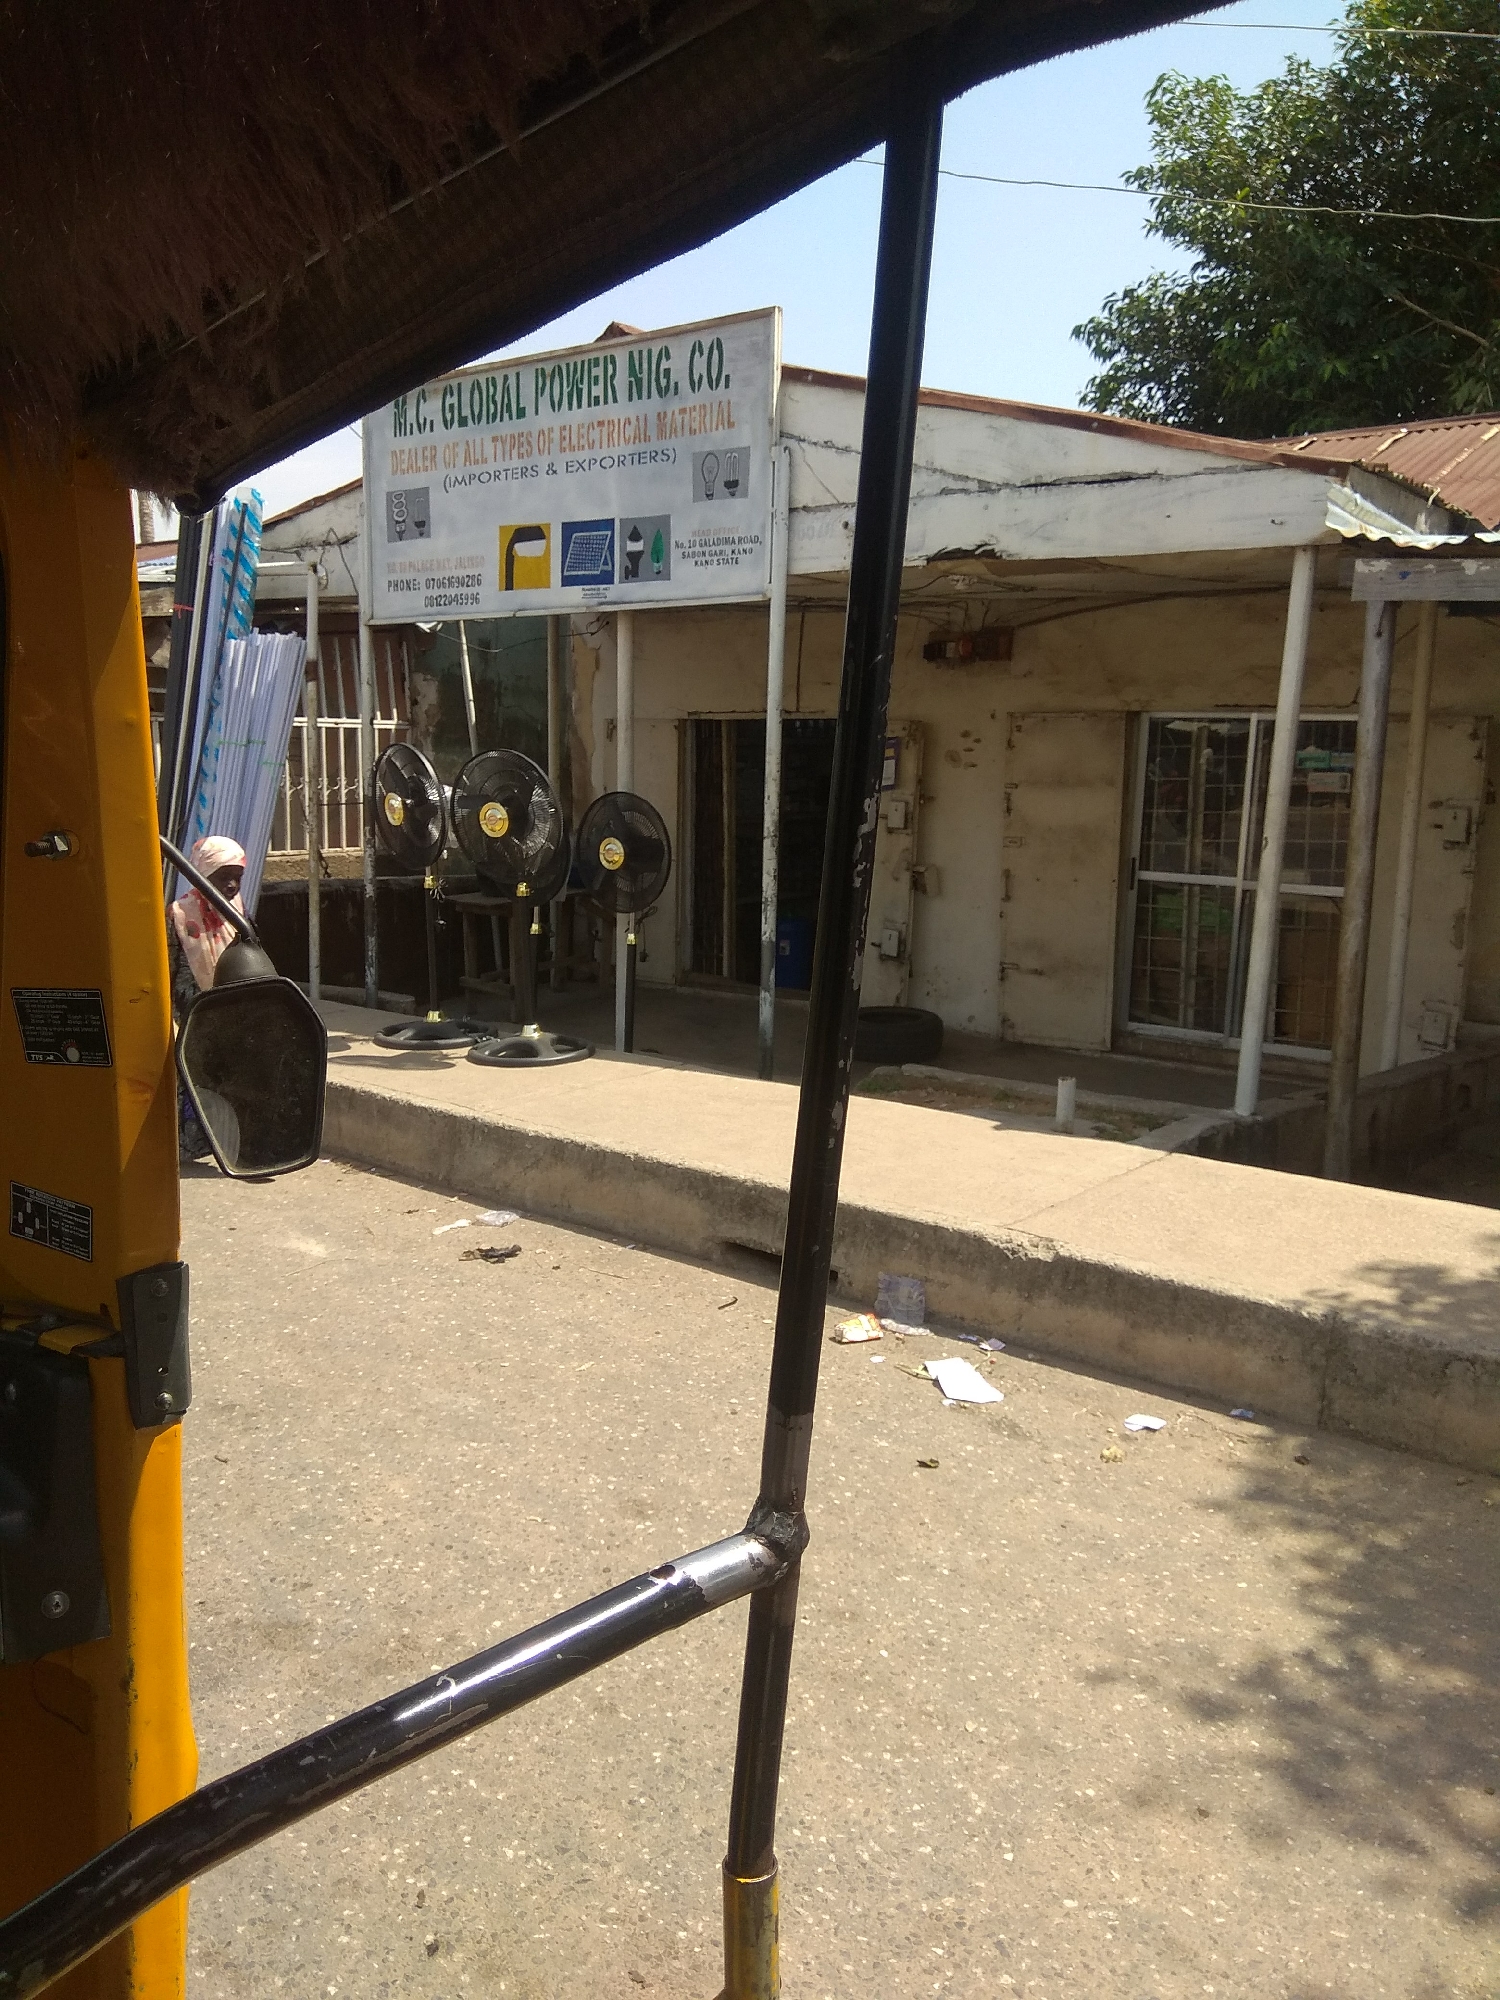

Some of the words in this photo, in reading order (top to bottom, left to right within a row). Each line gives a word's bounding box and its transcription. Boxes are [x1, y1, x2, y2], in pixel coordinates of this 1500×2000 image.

[441, 371, 526, 430] GLOBAL
[534, 354, 618, 416] POWER
[628, 345, 679, 402] NIG.
[688, 337, 731, 394] CO.
[391, 445, 437, 476] DEALER
[443, 441, 459, 469] OF
[463, 437, 487, 467] ALL
[491, 430, 533, 463] TYPES
[537, 427, 554, 456] OF
[559, 413, 651, 453] ELECTRICAL
[656, 399, 736, 440] MATERIAL
[443, 463, 539, 493] (IMPORTERS
[545, 461, 558, 476] &
[565, 447, 677, 474] EXPORTERS)
[698, 535, 737, 548] GALADIMA
[737, 534, 763, 546] ROAD,
[681, 549, 707, 559] SABON
[730, 547, 754, 556] KANO
[694, 559, 715, 567] KANO
[716, 557, 739, 566] STATE
[387, 578, 421, 592] PHONE:
